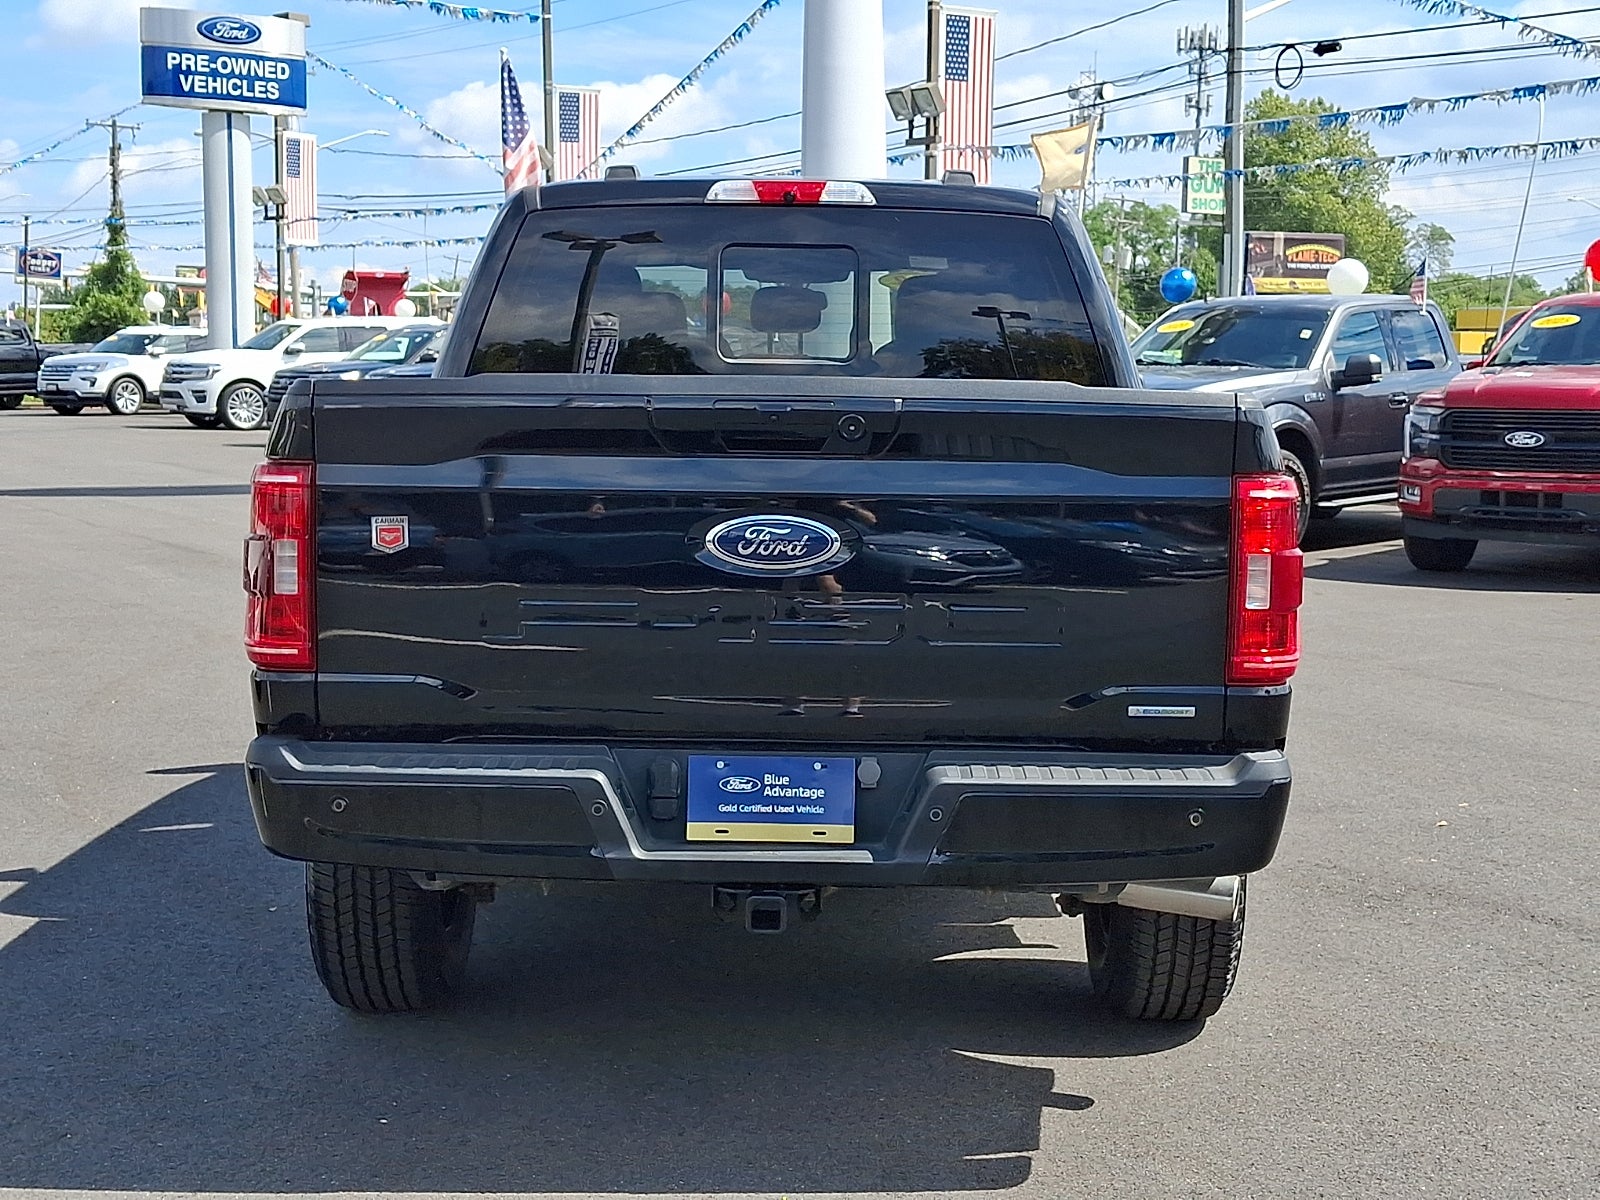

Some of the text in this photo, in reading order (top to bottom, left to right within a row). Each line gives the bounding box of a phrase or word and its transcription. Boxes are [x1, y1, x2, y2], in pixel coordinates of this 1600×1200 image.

[212, 21, 249, 39] Ford
[166, 52, 290, 80] PRE-OWNED
[179, 74, 280, 100] VEHICLES
[1198, 160, 1222, 173] THE
[737, 526, 809, 556] Ford
[763, 773, 790, 785] Blue
[763, 786, 825, 800] Advantage
[718, 803, 825, 814] Gold Certified Used Vehicle
